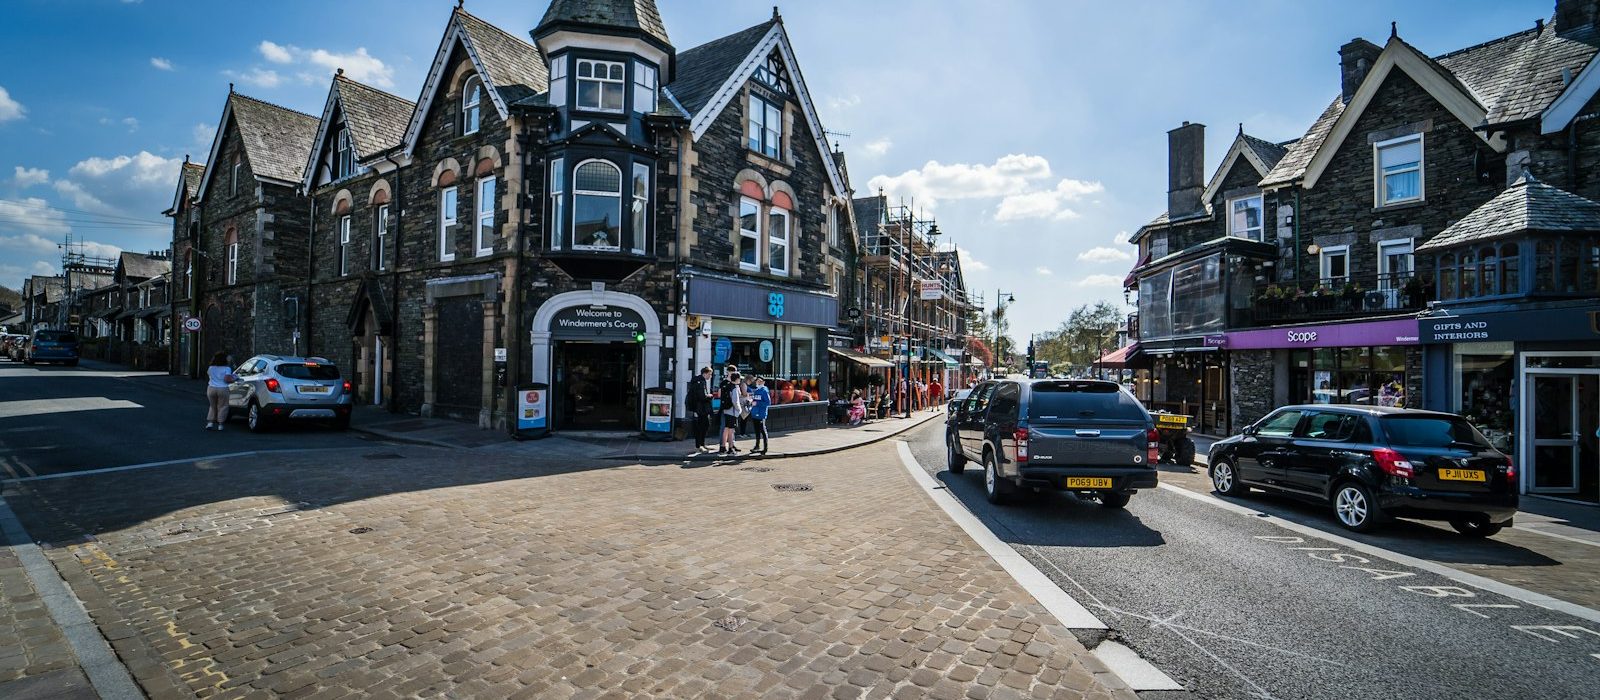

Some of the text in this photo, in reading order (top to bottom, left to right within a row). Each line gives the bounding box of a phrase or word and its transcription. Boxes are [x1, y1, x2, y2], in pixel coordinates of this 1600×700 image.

[576, 309, 612, 318] Welcome
[559, 319, 639, 330] Windermere's Co-op
[1433, 321, 1487, 331] GIFTS AND
[1287, 330, 1318, 343] Scope
[1434, 331, 1489, 340] INTERIORS
[1207, 337, 1226, 345] Scope
[1445, 469, 1479, 479] PJ11 UXS
[1070, 478, 1109, 487] PO69 UBV
[1254, 536, 1600, 660] DISABLE
